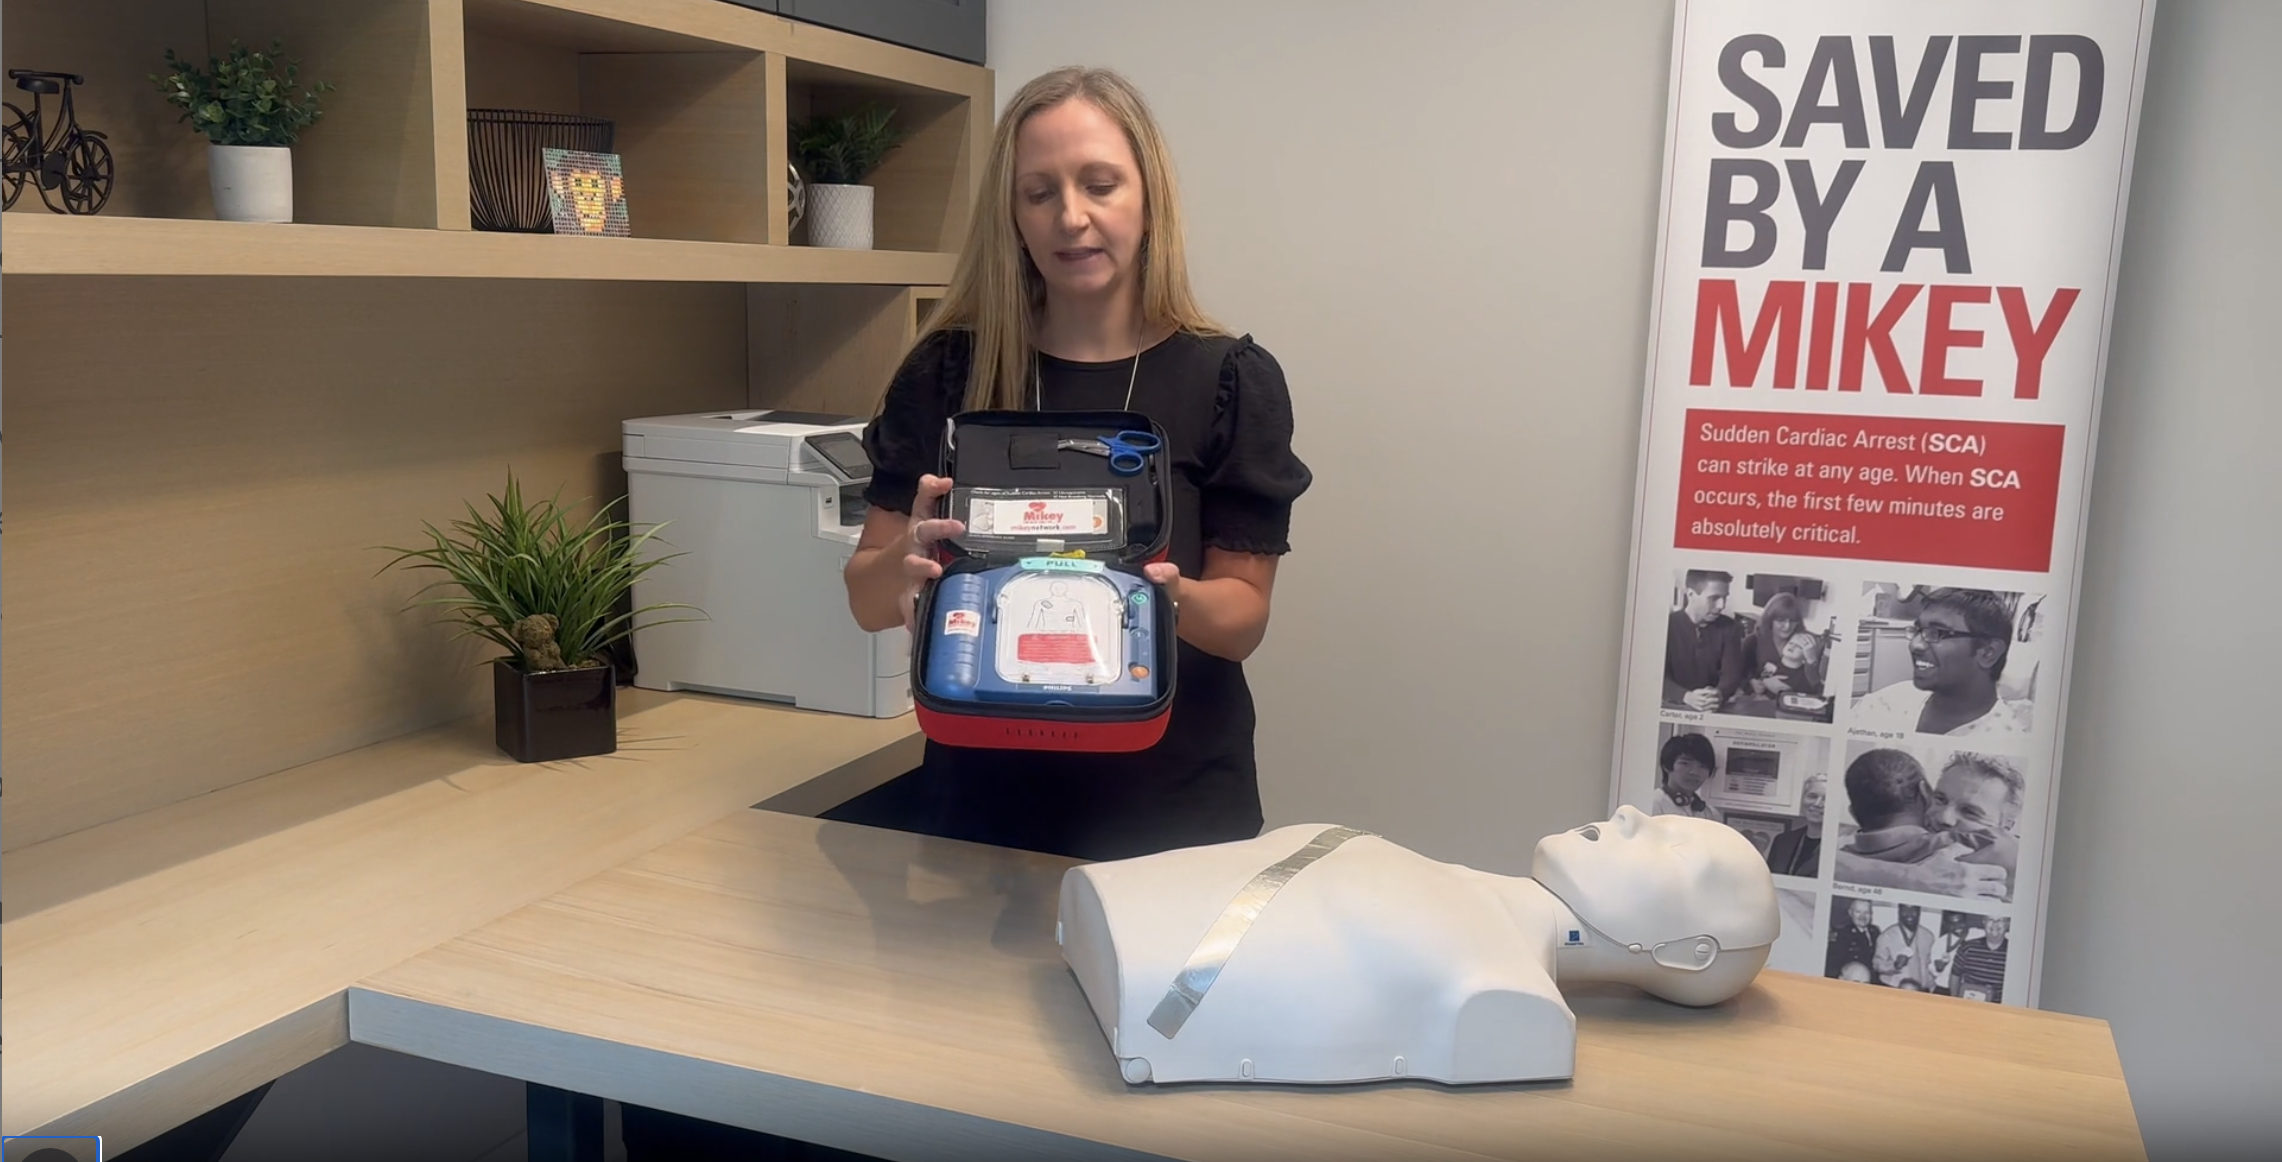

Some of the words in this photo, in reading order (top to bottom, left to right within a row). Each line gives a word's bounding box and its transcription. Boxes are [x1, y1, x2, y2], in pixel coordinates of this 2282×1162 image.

[1711, 33, 2105, 151] SAVED
[1700, 158, 1867, 271] BY
[1880, 161, 1972, 274] A
[1689, 278, 2081, 400] MIKEY
[1700, 422, 1770, 444] Sudden
[1776, 426, 1847, 447] Cardiac
[1853, 430, 1916, 451] Arrest
[1921, 432, 1986, 457] (SCA)
[1697, 458, 1731, 473] can
[1736, 457, 1788, 477] strike
[1794, 462, 1814, 478] at
[1819, 465, 1853, 484] any
[1858, 466, 1898, 485] age.
[1905, 464, 1964, 486] When
[1969, 468, 2021, 489] SCA
[1023, 511, 1064, 523] Mikey
[1694, 489, 1762, 510] occurs,
[1767, 489, 1798, 509] the
[1803, 491, 1842, 511] first
[1846, 493, 1884, 513] few
[1888, 497, 1965, 519] minutes
[1971, 505, 2004, 521] are
[1691, 517, 1786, 543] absolutely
[1792, 522, 1861, 545] critical.
[1046, 560, 1077, 568] PULL
[1684, 713, 1698, 721] age
